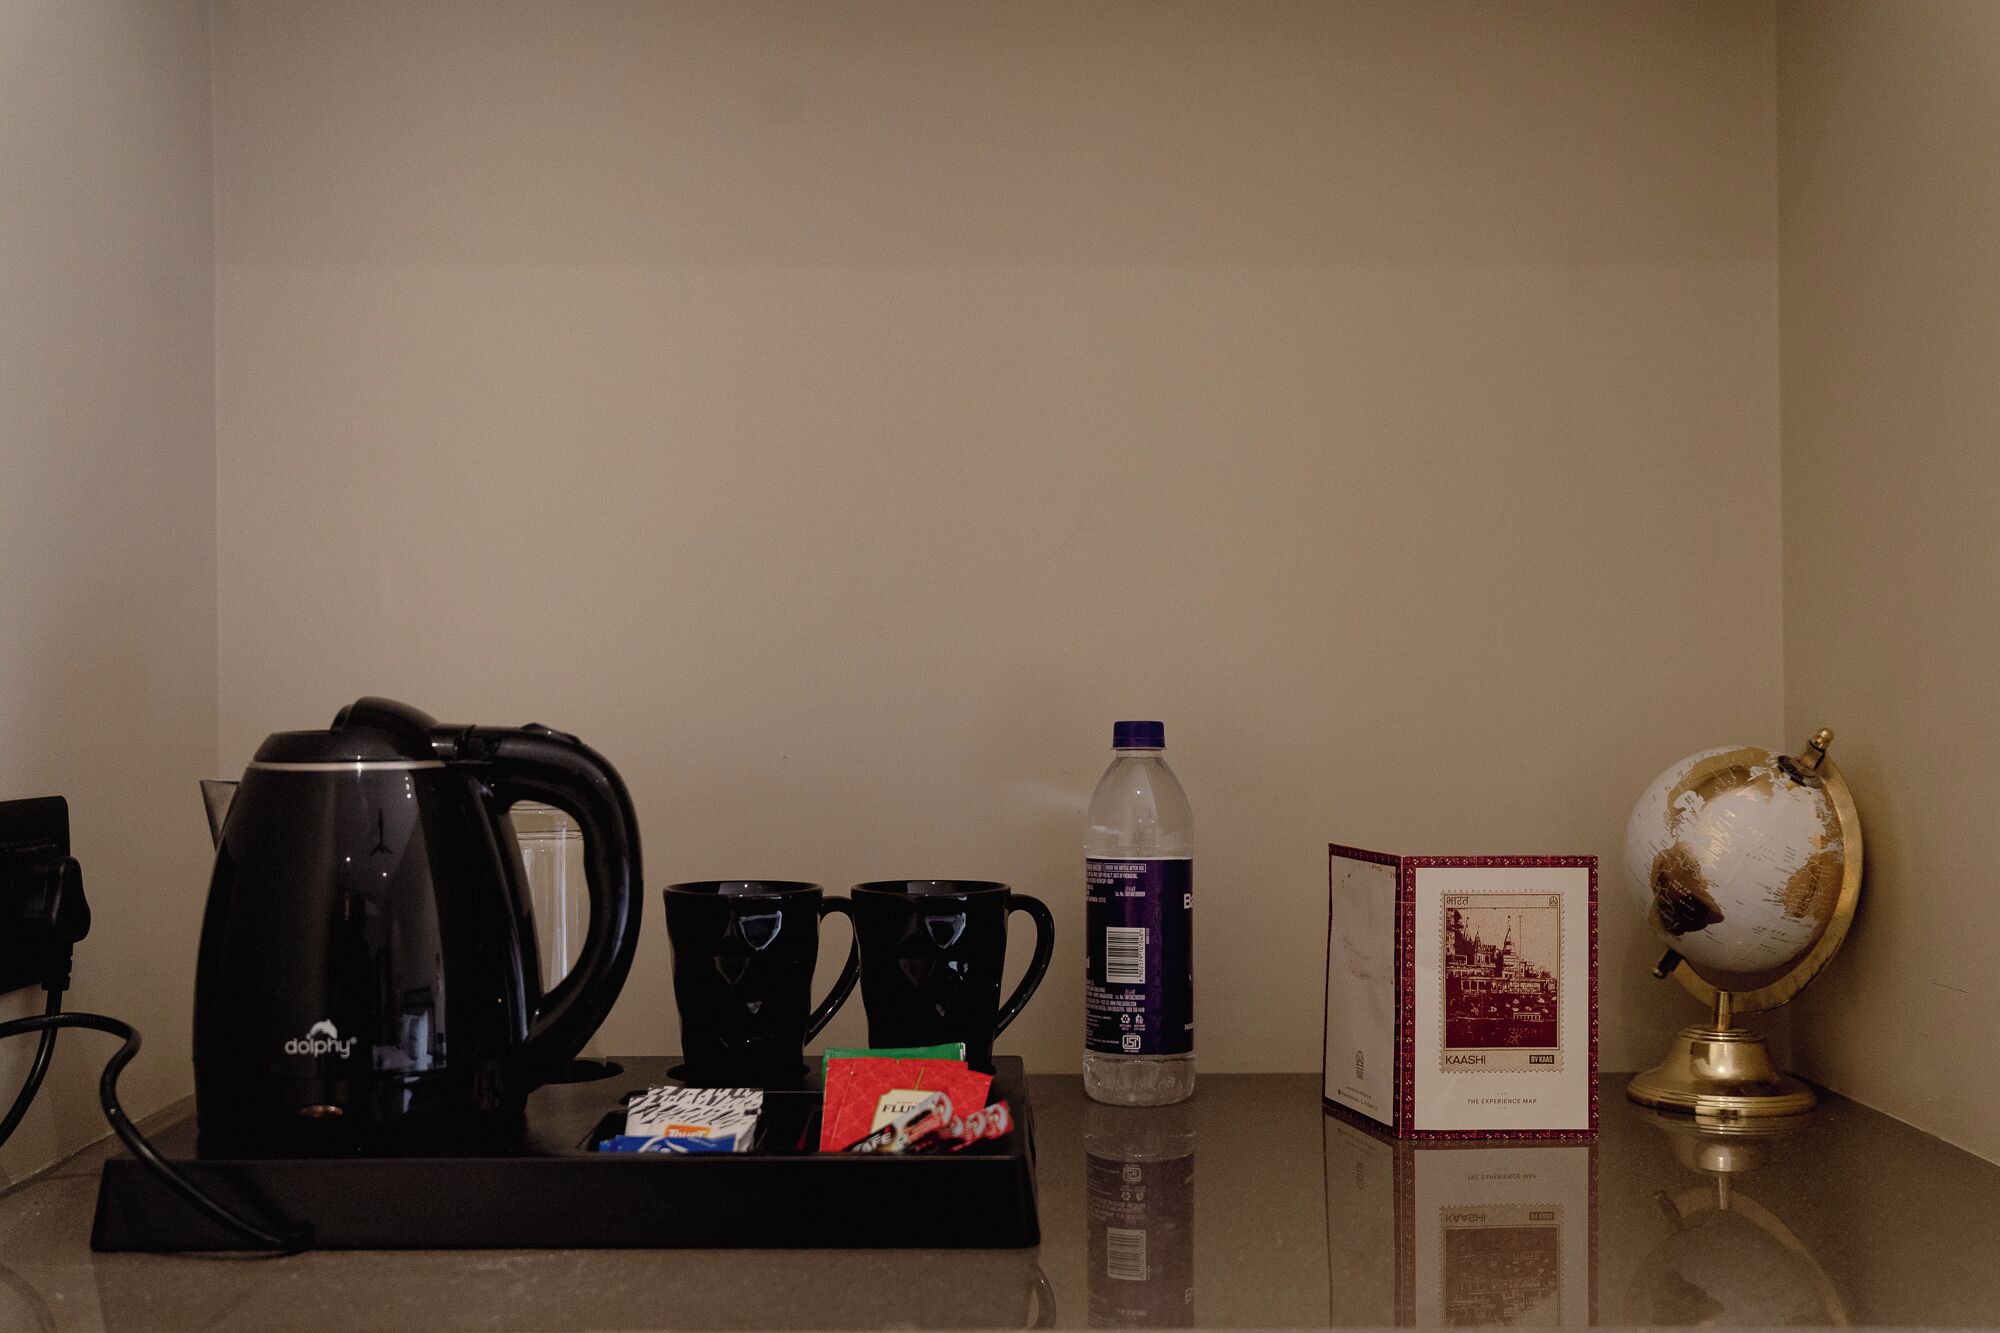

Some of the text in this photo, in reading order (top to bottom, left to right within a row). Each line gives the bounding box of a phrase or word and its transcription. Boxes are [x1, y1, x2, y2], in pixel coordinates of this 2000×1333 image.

[1446, 896, 1469, 906] भारत
[1445, 1055, 1486, 1065] KAASHI
[1530, 1055, 1553, 1063] BY KAAS
[882, 1103, 915, 1113] FLU
